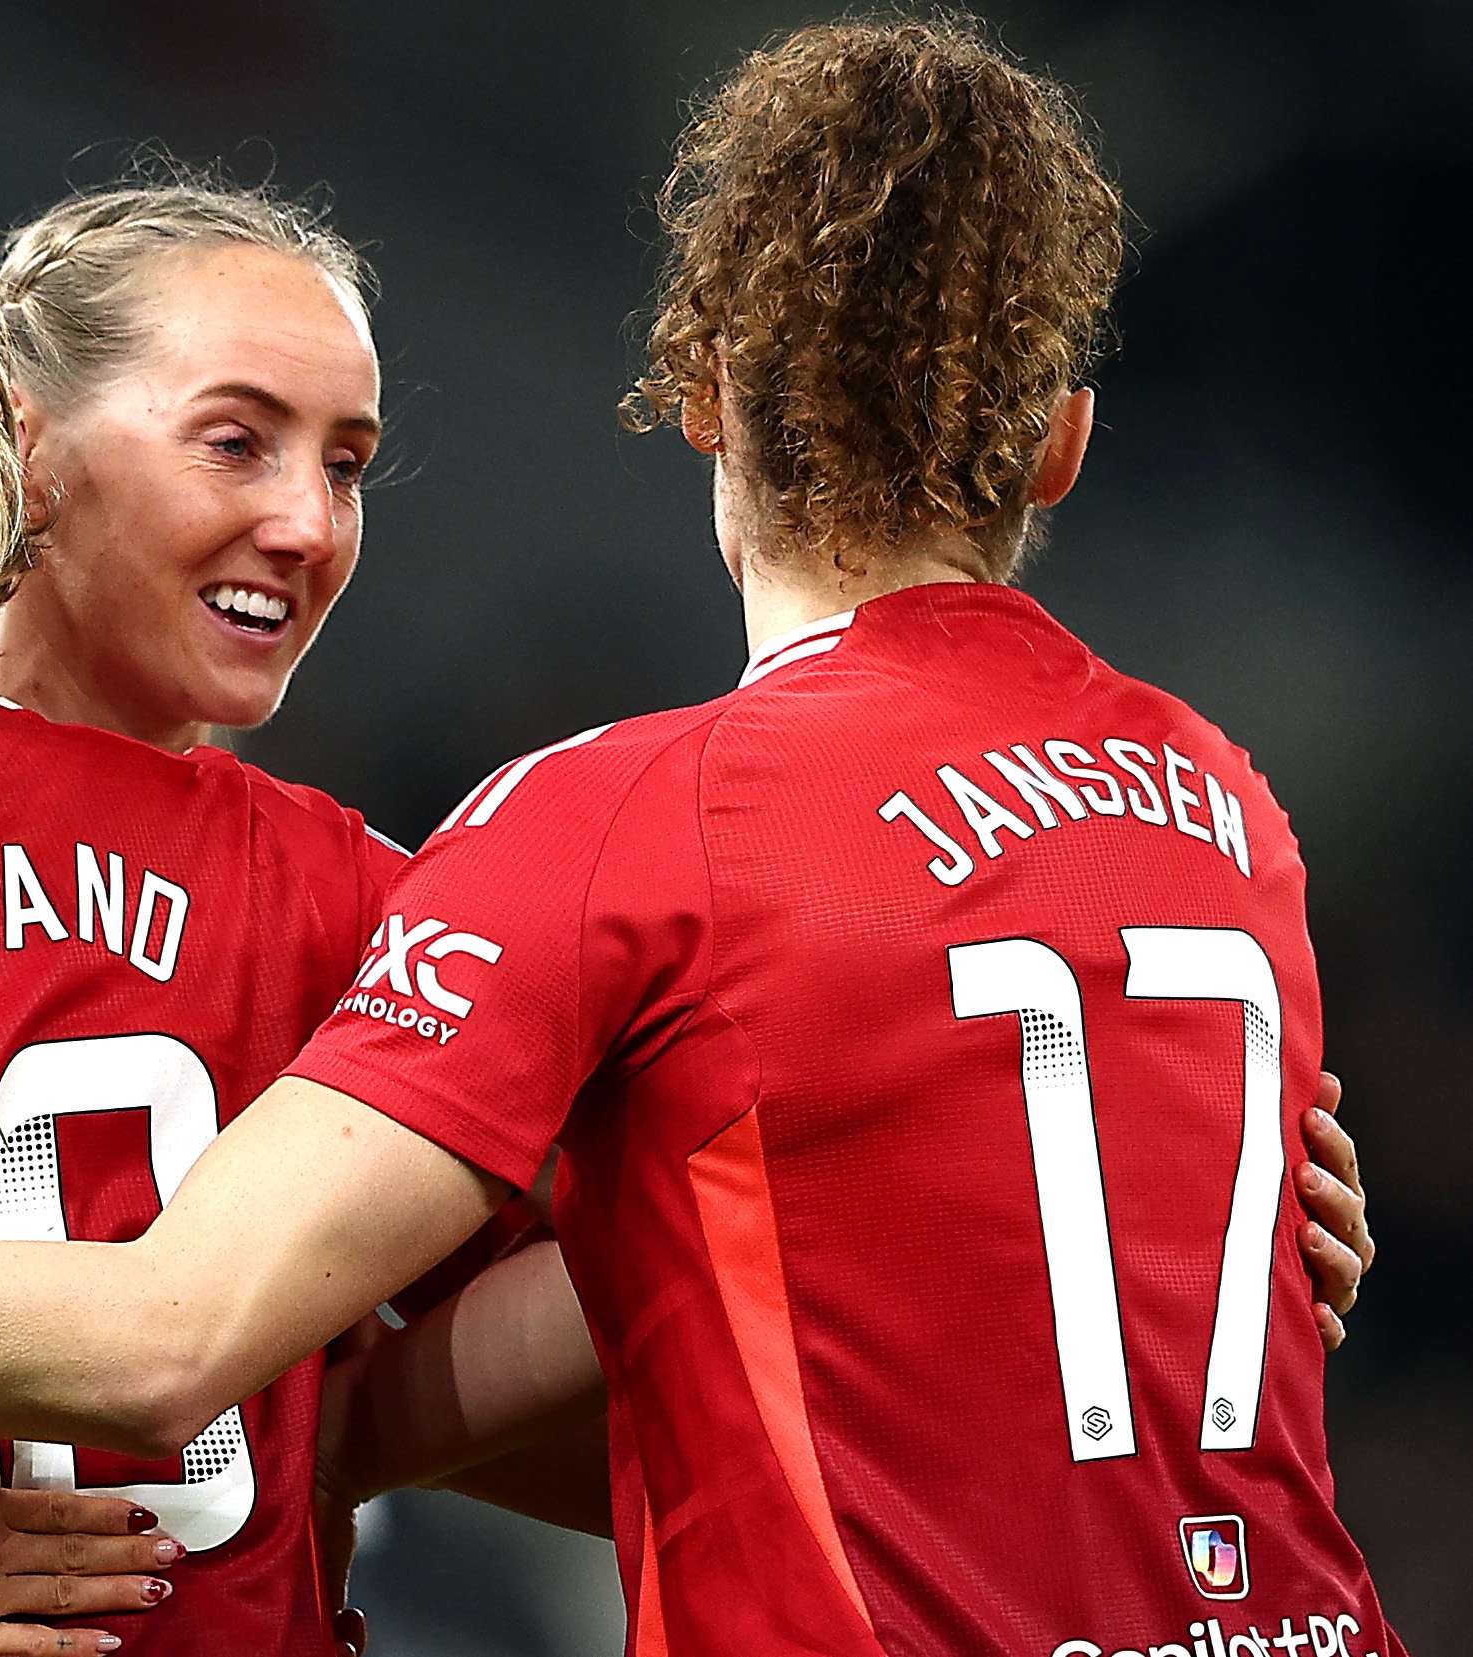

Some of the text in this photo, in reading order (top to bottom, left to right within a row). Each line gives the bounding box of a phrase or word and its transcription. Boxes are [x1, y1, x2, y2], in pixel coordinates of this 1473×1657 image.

[877, 737, 1252, 887] JANSSEN
[334, 992, 459, 1045] NOLOGY
[948, 926, 1285, 1460] 17
